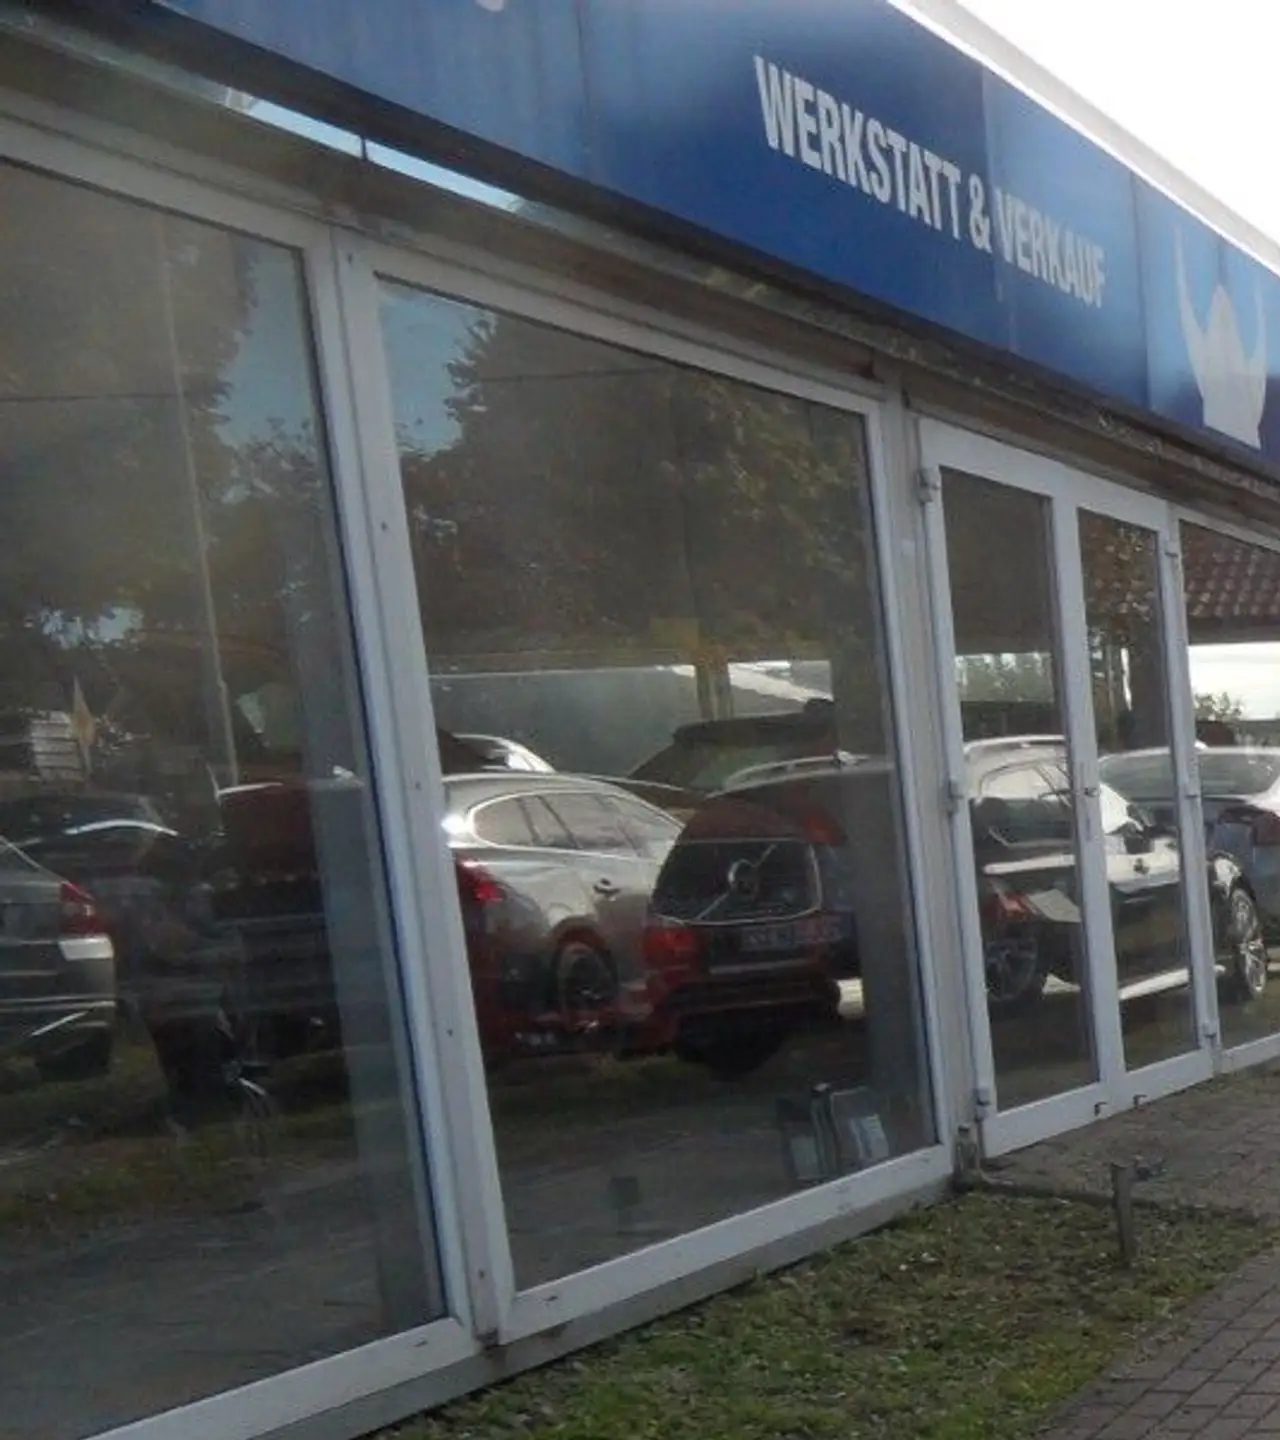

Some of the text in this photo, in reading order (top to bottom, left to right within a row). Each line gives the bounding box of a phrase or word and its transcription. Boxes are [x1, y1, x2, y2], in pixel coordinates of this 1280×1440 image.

[753, 55, 1106, 308] WERKSTATT & VERKAUF
